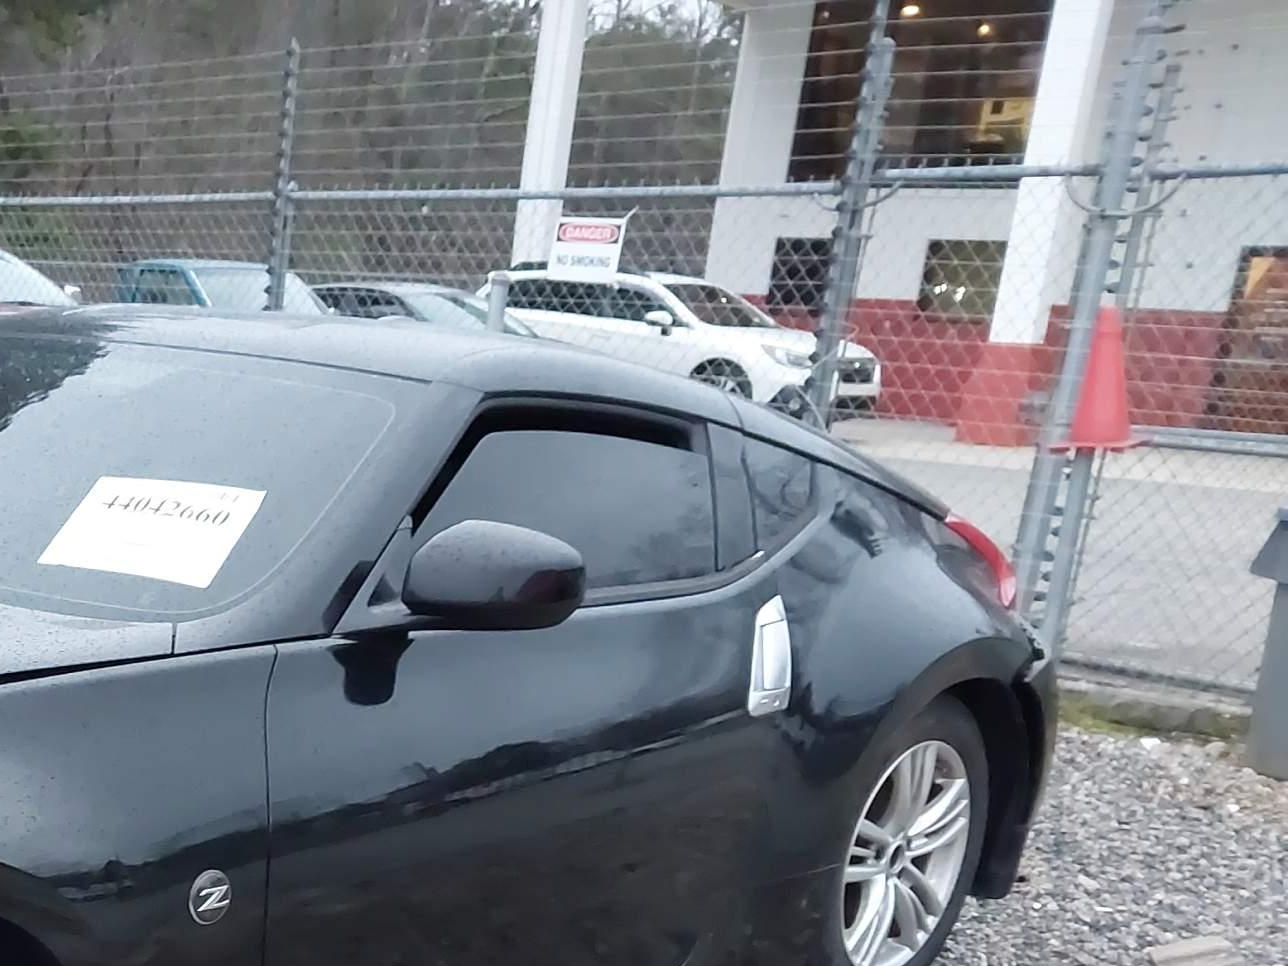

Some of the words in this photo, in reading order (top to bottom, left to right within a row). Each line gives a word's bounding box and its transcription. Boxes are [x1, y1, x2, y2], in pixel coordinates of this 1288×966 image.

[564, 226, 612, 239] DANGER
[556, 254, 569, 266] NO
[570, 255, 612, 268] SMOKING
[101, 494, 231, 526] 44042660
